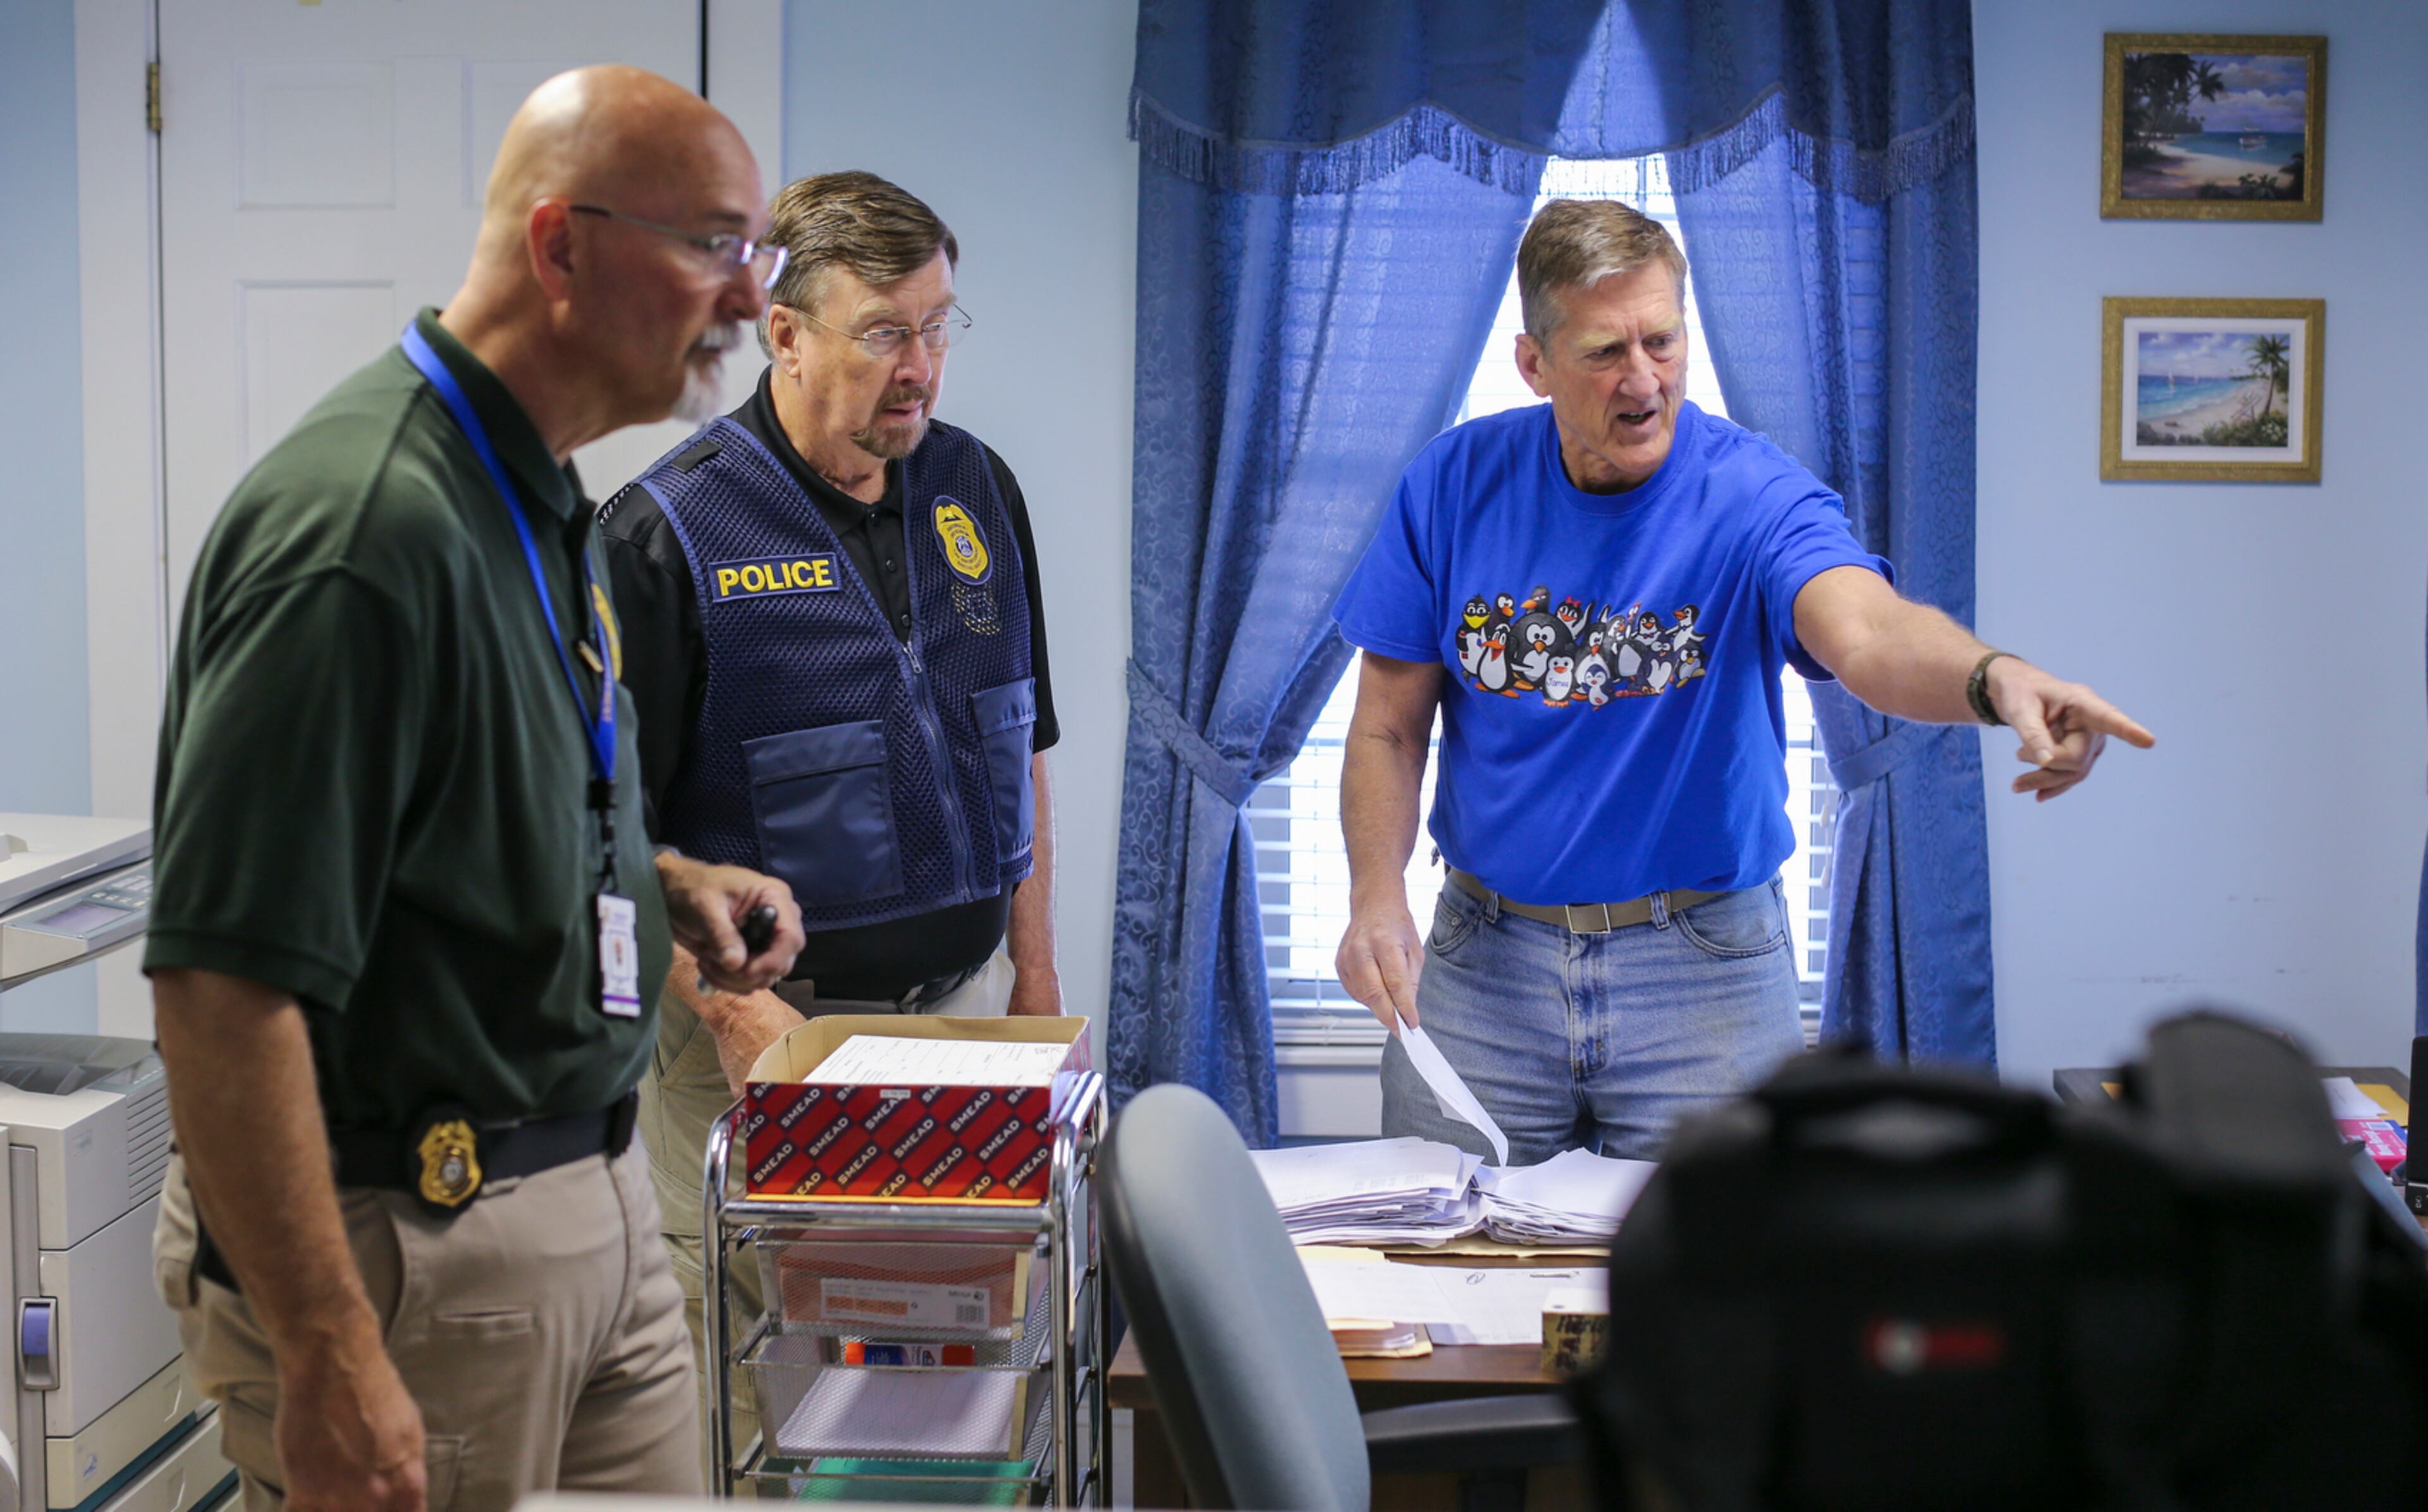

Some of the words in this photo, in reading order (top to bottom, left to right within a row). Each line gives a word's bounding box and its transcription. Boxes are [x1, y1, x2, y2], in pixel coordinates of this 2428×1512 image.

[717, 559, 833, 596] POLICE
[753, 1083, 772, 1098] SM
[780, 1088, 820, 1128] SMEAD
[837, 1084, 855, 1100] SM
[922, 1085, 941, 1102] SM
[1008, 1087, 1027, 1104] SM
[865, 1098, 902, 1130] SMEA
[951, 1092, 991, 1131] SMEAD
[809, 1117, 849, 1156] SMEAD
[894, 1119, 933, 1158] SMEAD
[979, 1120, 1019, 1160] SMEAD
[754, 1143, 792, 1183] SMEAD
[838, 1146, 877, 1185] SMEAD
[923, 1147, 962, 1186] SMEAD
[1008, 1149, 1048, 1188] SMEAD
[794, 1173, 821, 1195] EAD
[880, 1174, 905, 1197] EAD
[964, 1176, 991, 1198] EAD
